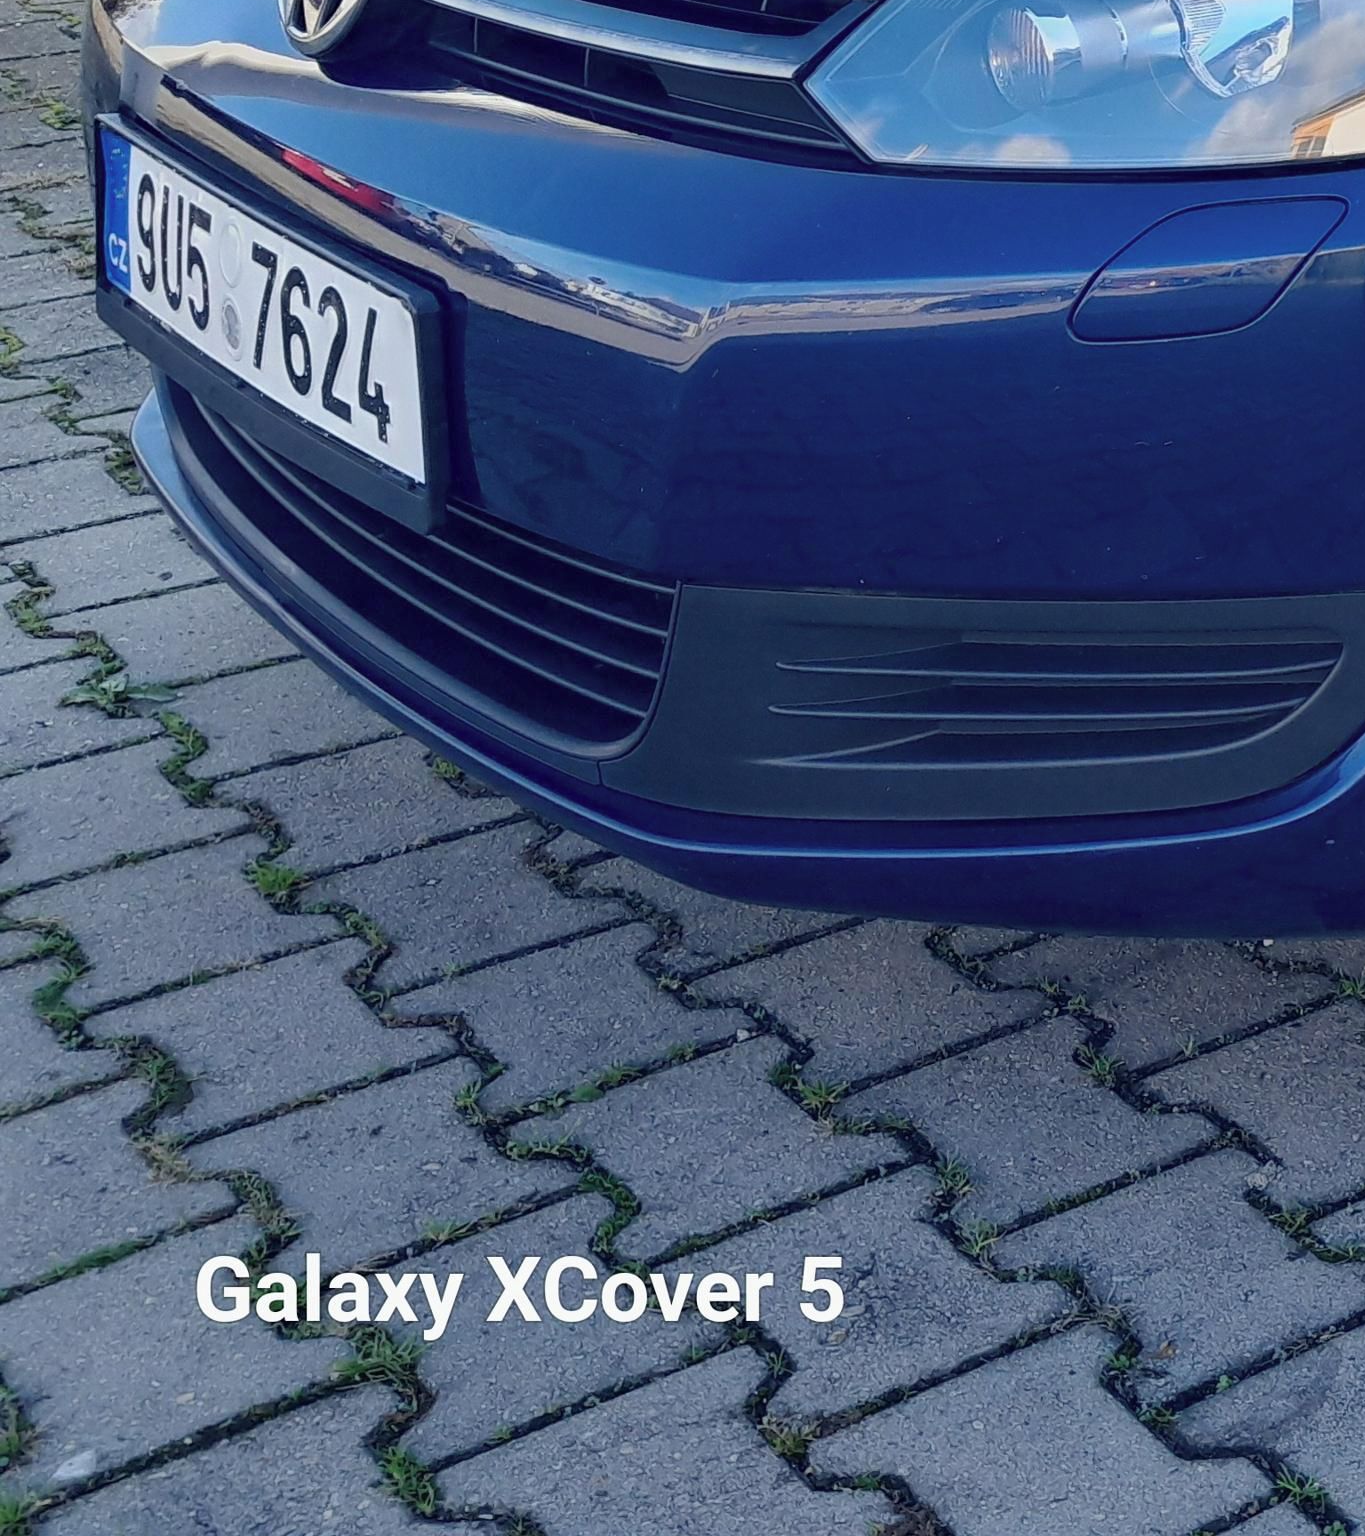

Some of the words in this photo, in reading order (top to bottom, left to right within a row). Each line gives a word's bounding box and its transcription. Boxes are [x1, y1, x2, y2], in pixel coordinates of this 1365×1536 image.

[108, 233, 128, 273] CZ
[136, 173, 212, 331] 9U5
[252, 241, 391, 444] 7624
